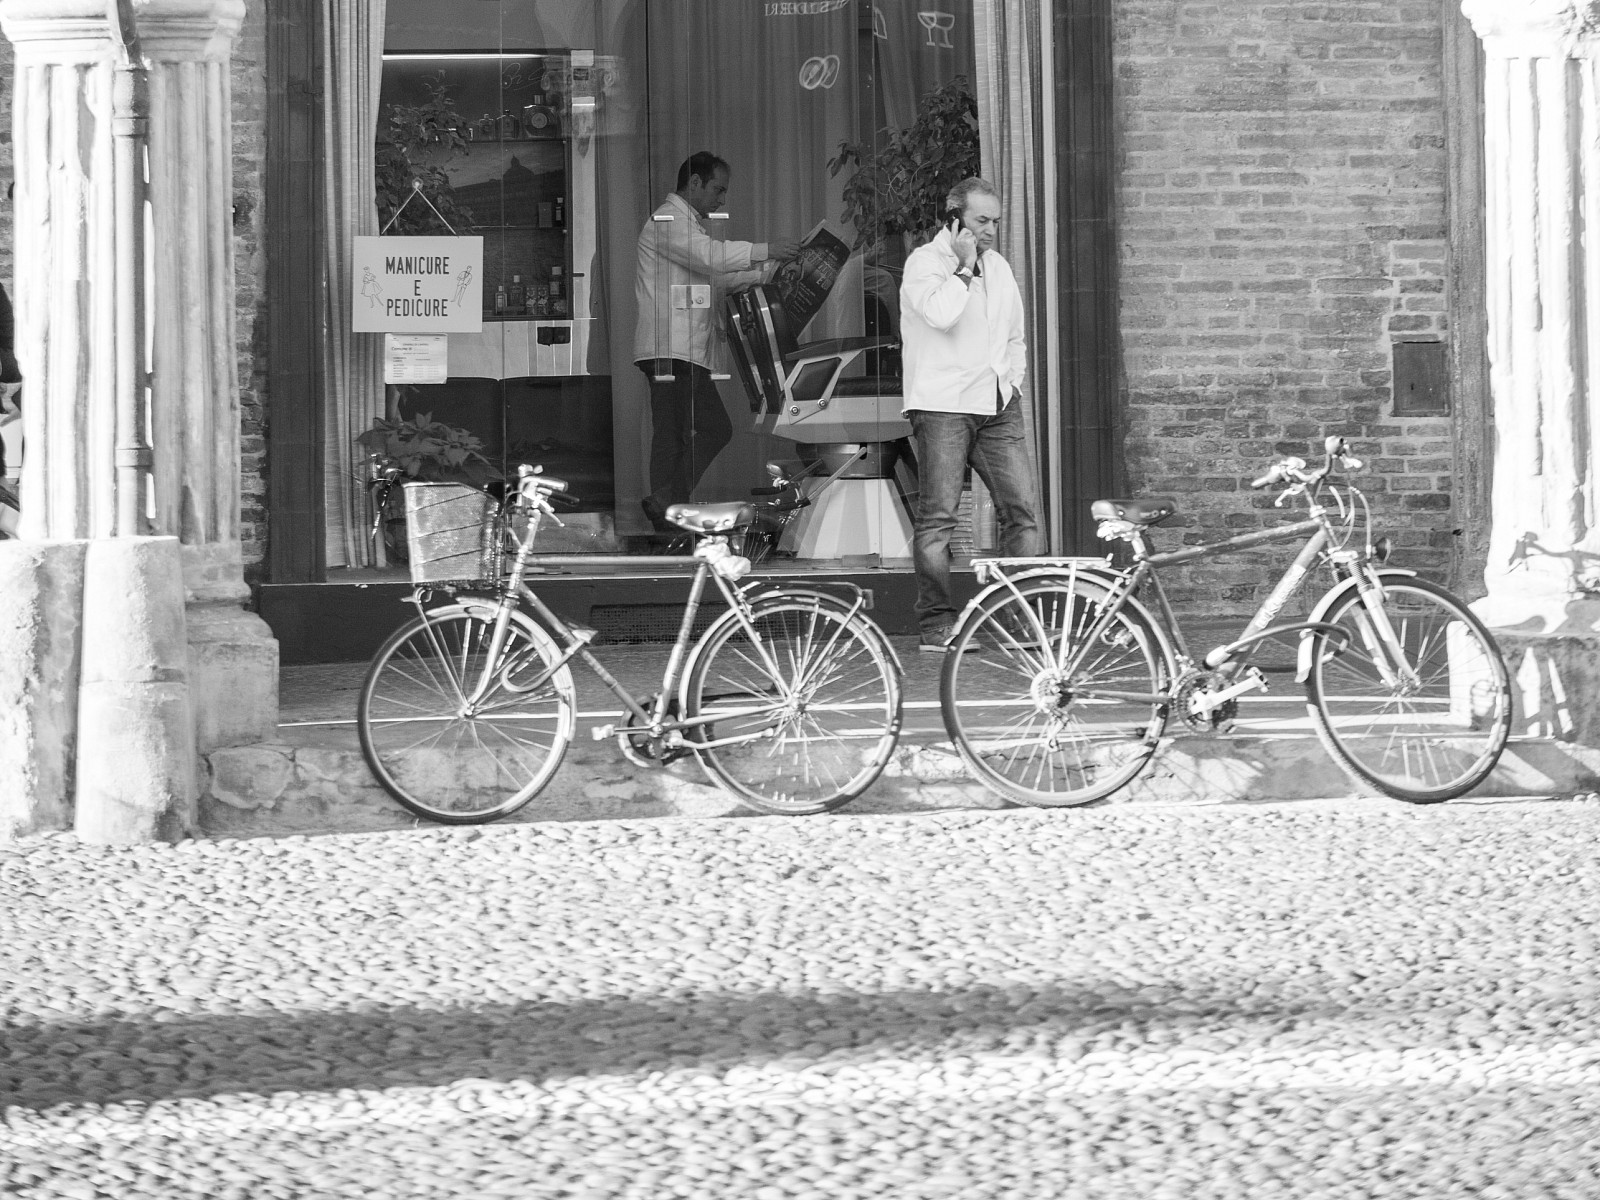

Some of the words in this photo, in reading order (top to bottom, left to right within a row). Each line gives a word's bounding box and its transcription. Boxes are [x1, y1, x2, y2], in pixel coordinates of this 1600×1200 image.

[385, 256, 450, 275] MANICURE
[414, 279, 422, 296] E
[386, 298, 449, 317] PEDICURE
